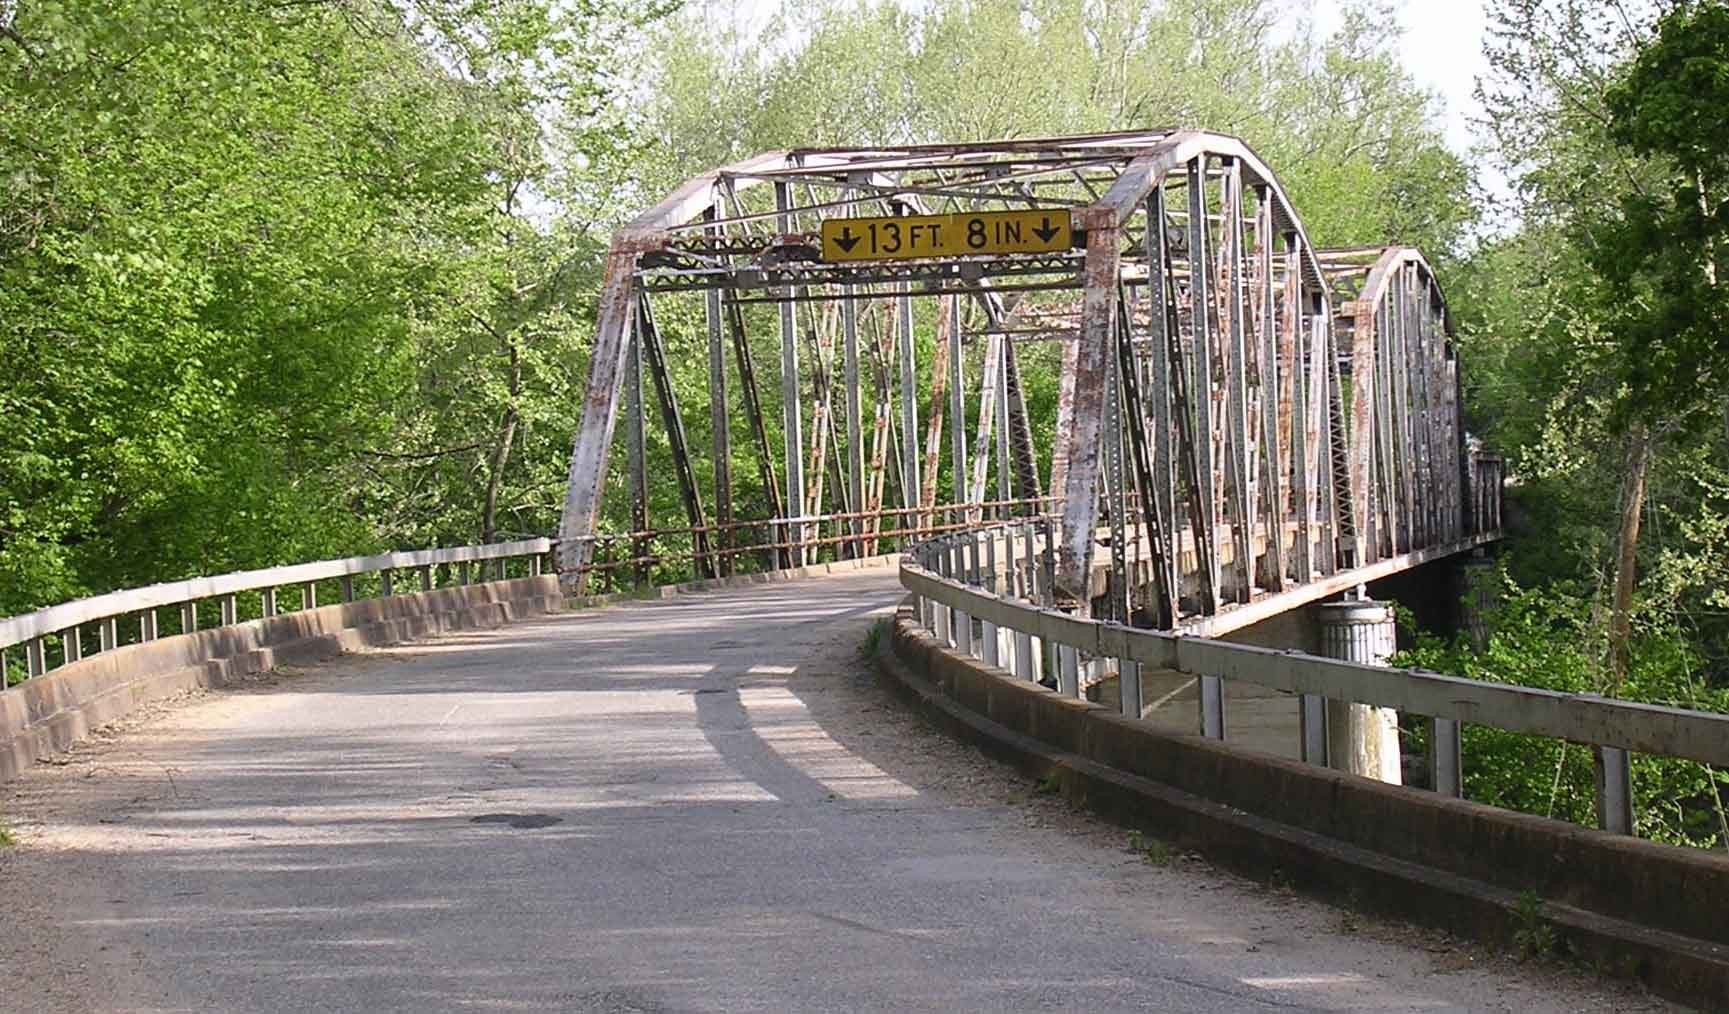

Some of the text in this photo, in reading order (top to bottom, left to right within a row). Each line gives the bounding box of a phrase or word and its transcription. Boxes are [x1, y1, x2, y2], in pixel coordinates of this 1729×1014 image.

[868, 219, 1027, 253] 13 FT. 8 IN.
